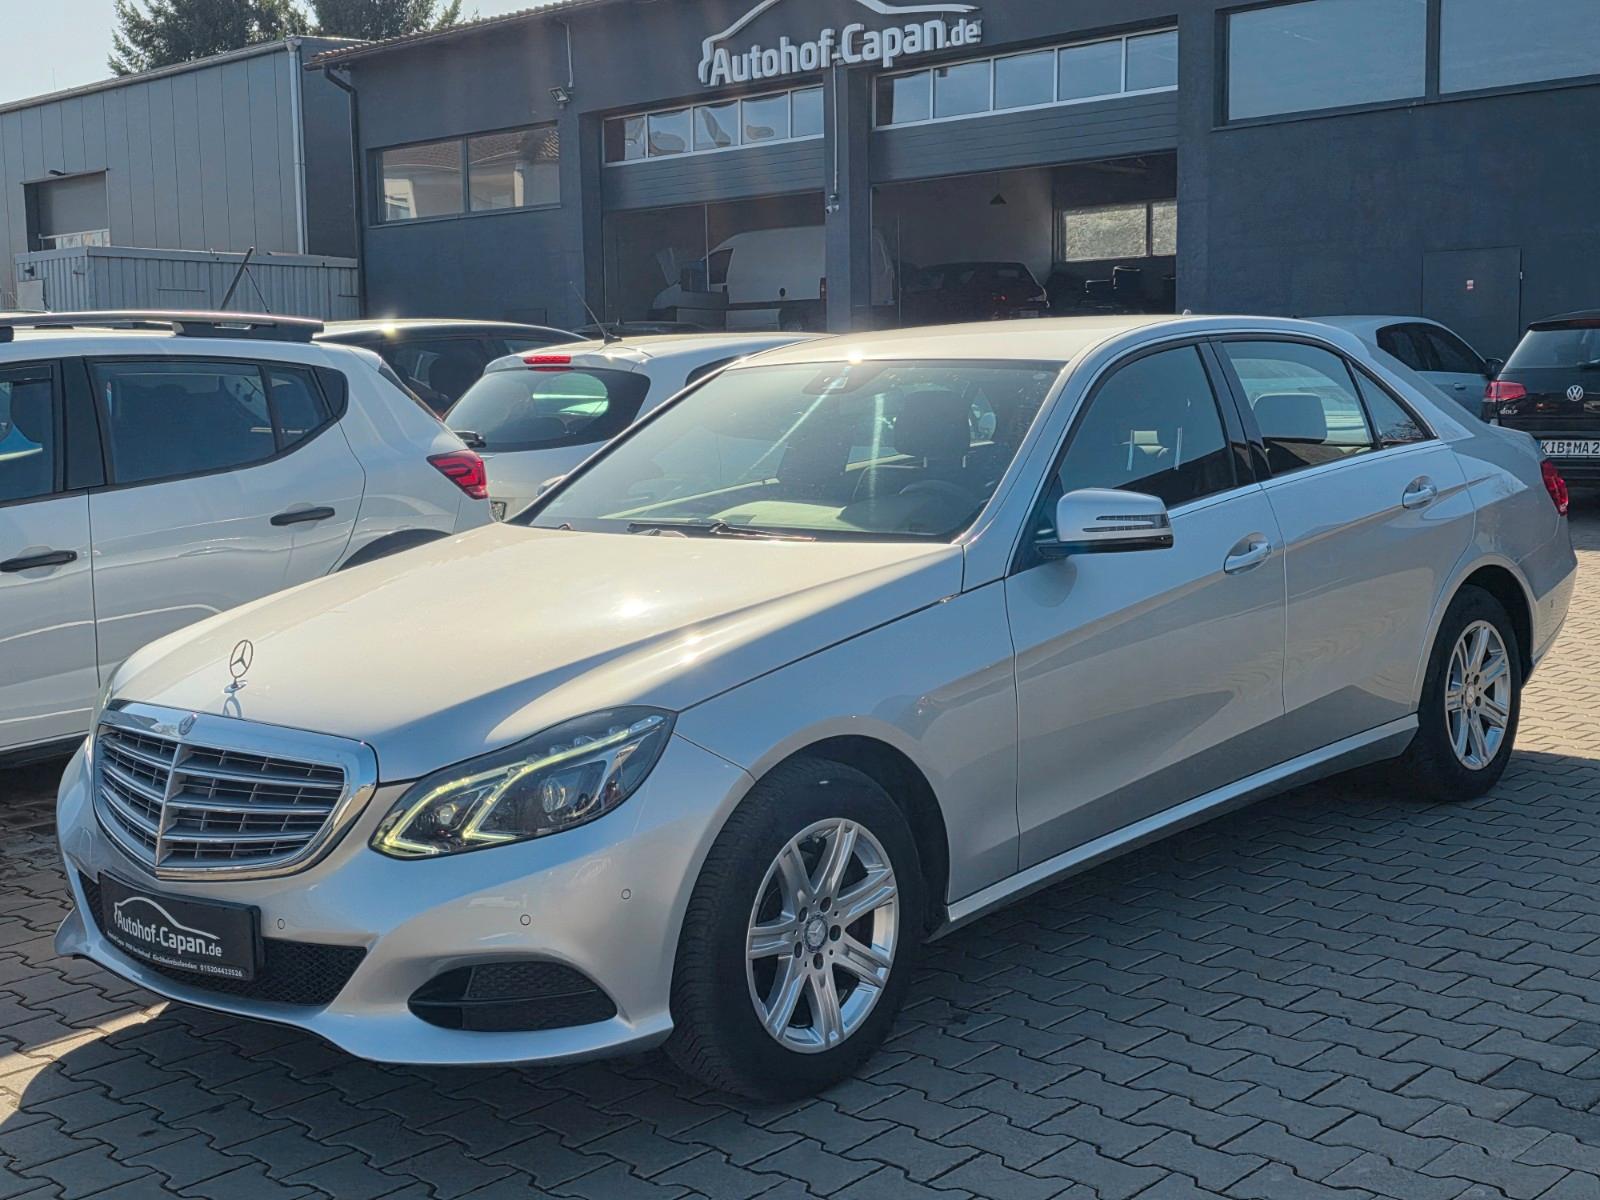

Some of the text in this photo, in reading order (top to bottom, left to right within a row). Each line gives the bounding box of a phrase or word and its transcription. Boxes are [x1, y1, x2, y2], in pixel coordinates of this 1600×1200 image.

[710, 19, 982, 86] Autohof-Capan.de
[1541, 441, 1565, 454] KIB
[1573, 441, 1589, 454] MA
[116, 911, 222, 957] Autohof-Capan.de
